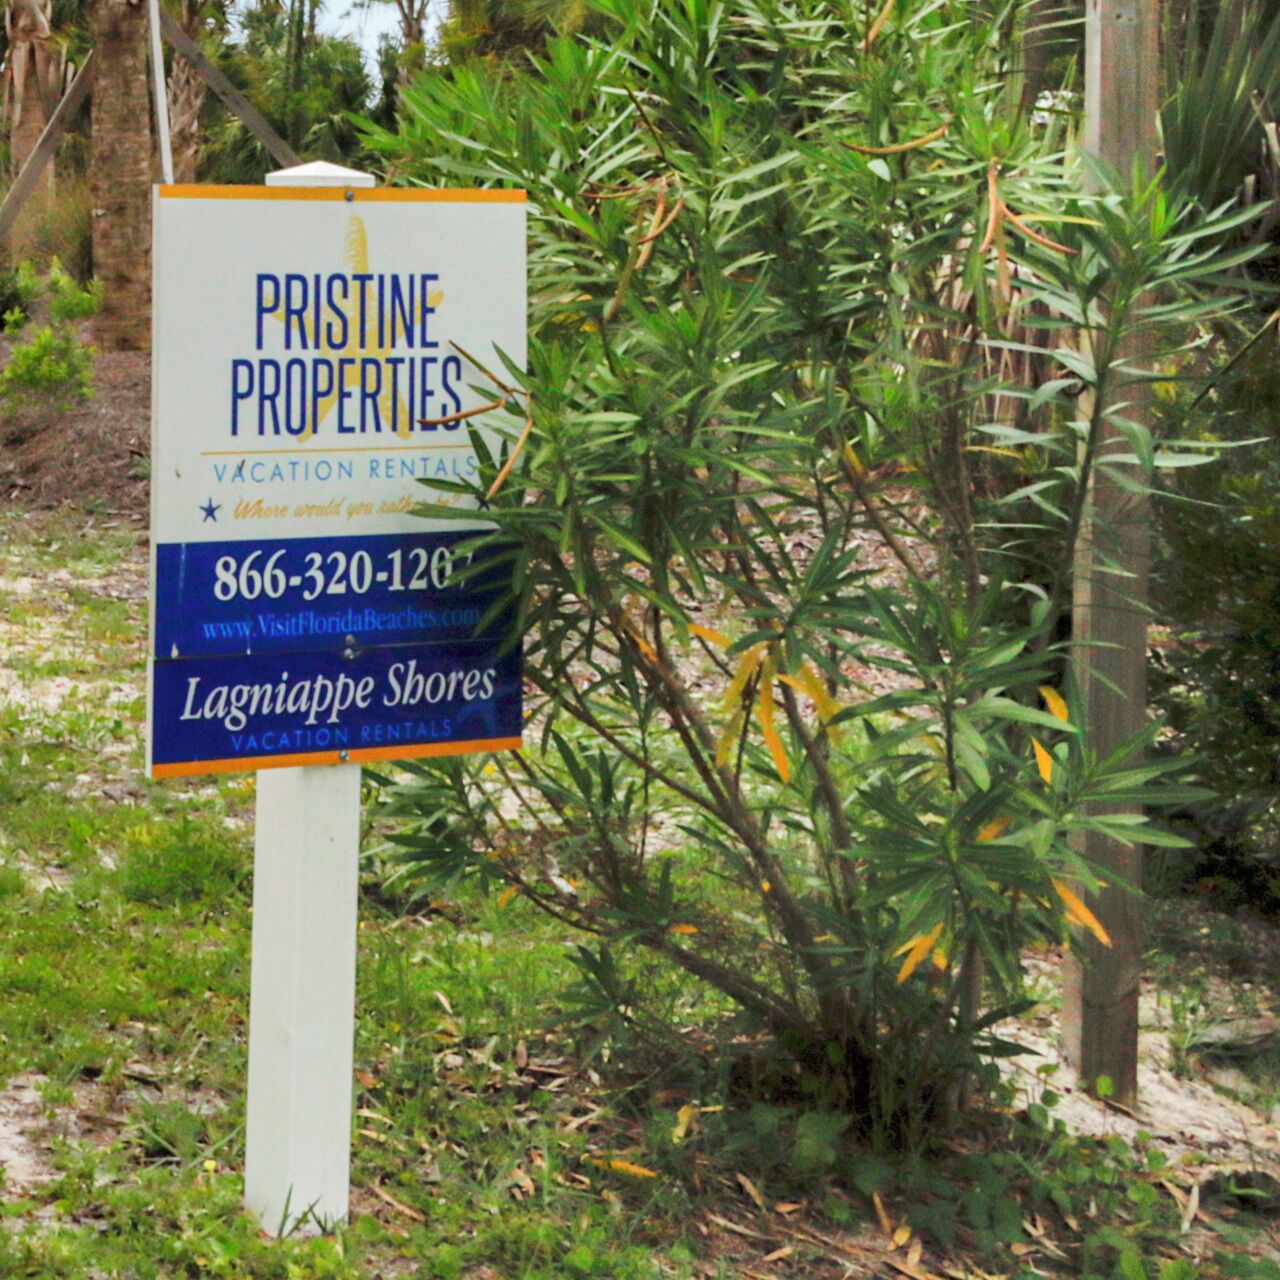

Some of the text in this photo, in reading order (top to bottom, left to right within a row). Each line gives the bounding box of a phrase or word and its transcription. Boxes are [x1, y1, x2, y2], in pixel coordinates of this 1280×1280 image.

[255, 273, 440, 351] PRISTINE
[230, 356, 462, 437] PROPERTIES
[213, 455, 477, 485] VACATION RENTALS
[234, 498, 289, 520] Where
[293, 497, 346, 518] would
[347, 501, 374, 521] you
[202, 604, 480, 642] www.VisitFloridaBeaches.com
[180, 659, 497, 731] Lagniappe Shores
[231, 719, 454, 752] VACATION RENTALS
